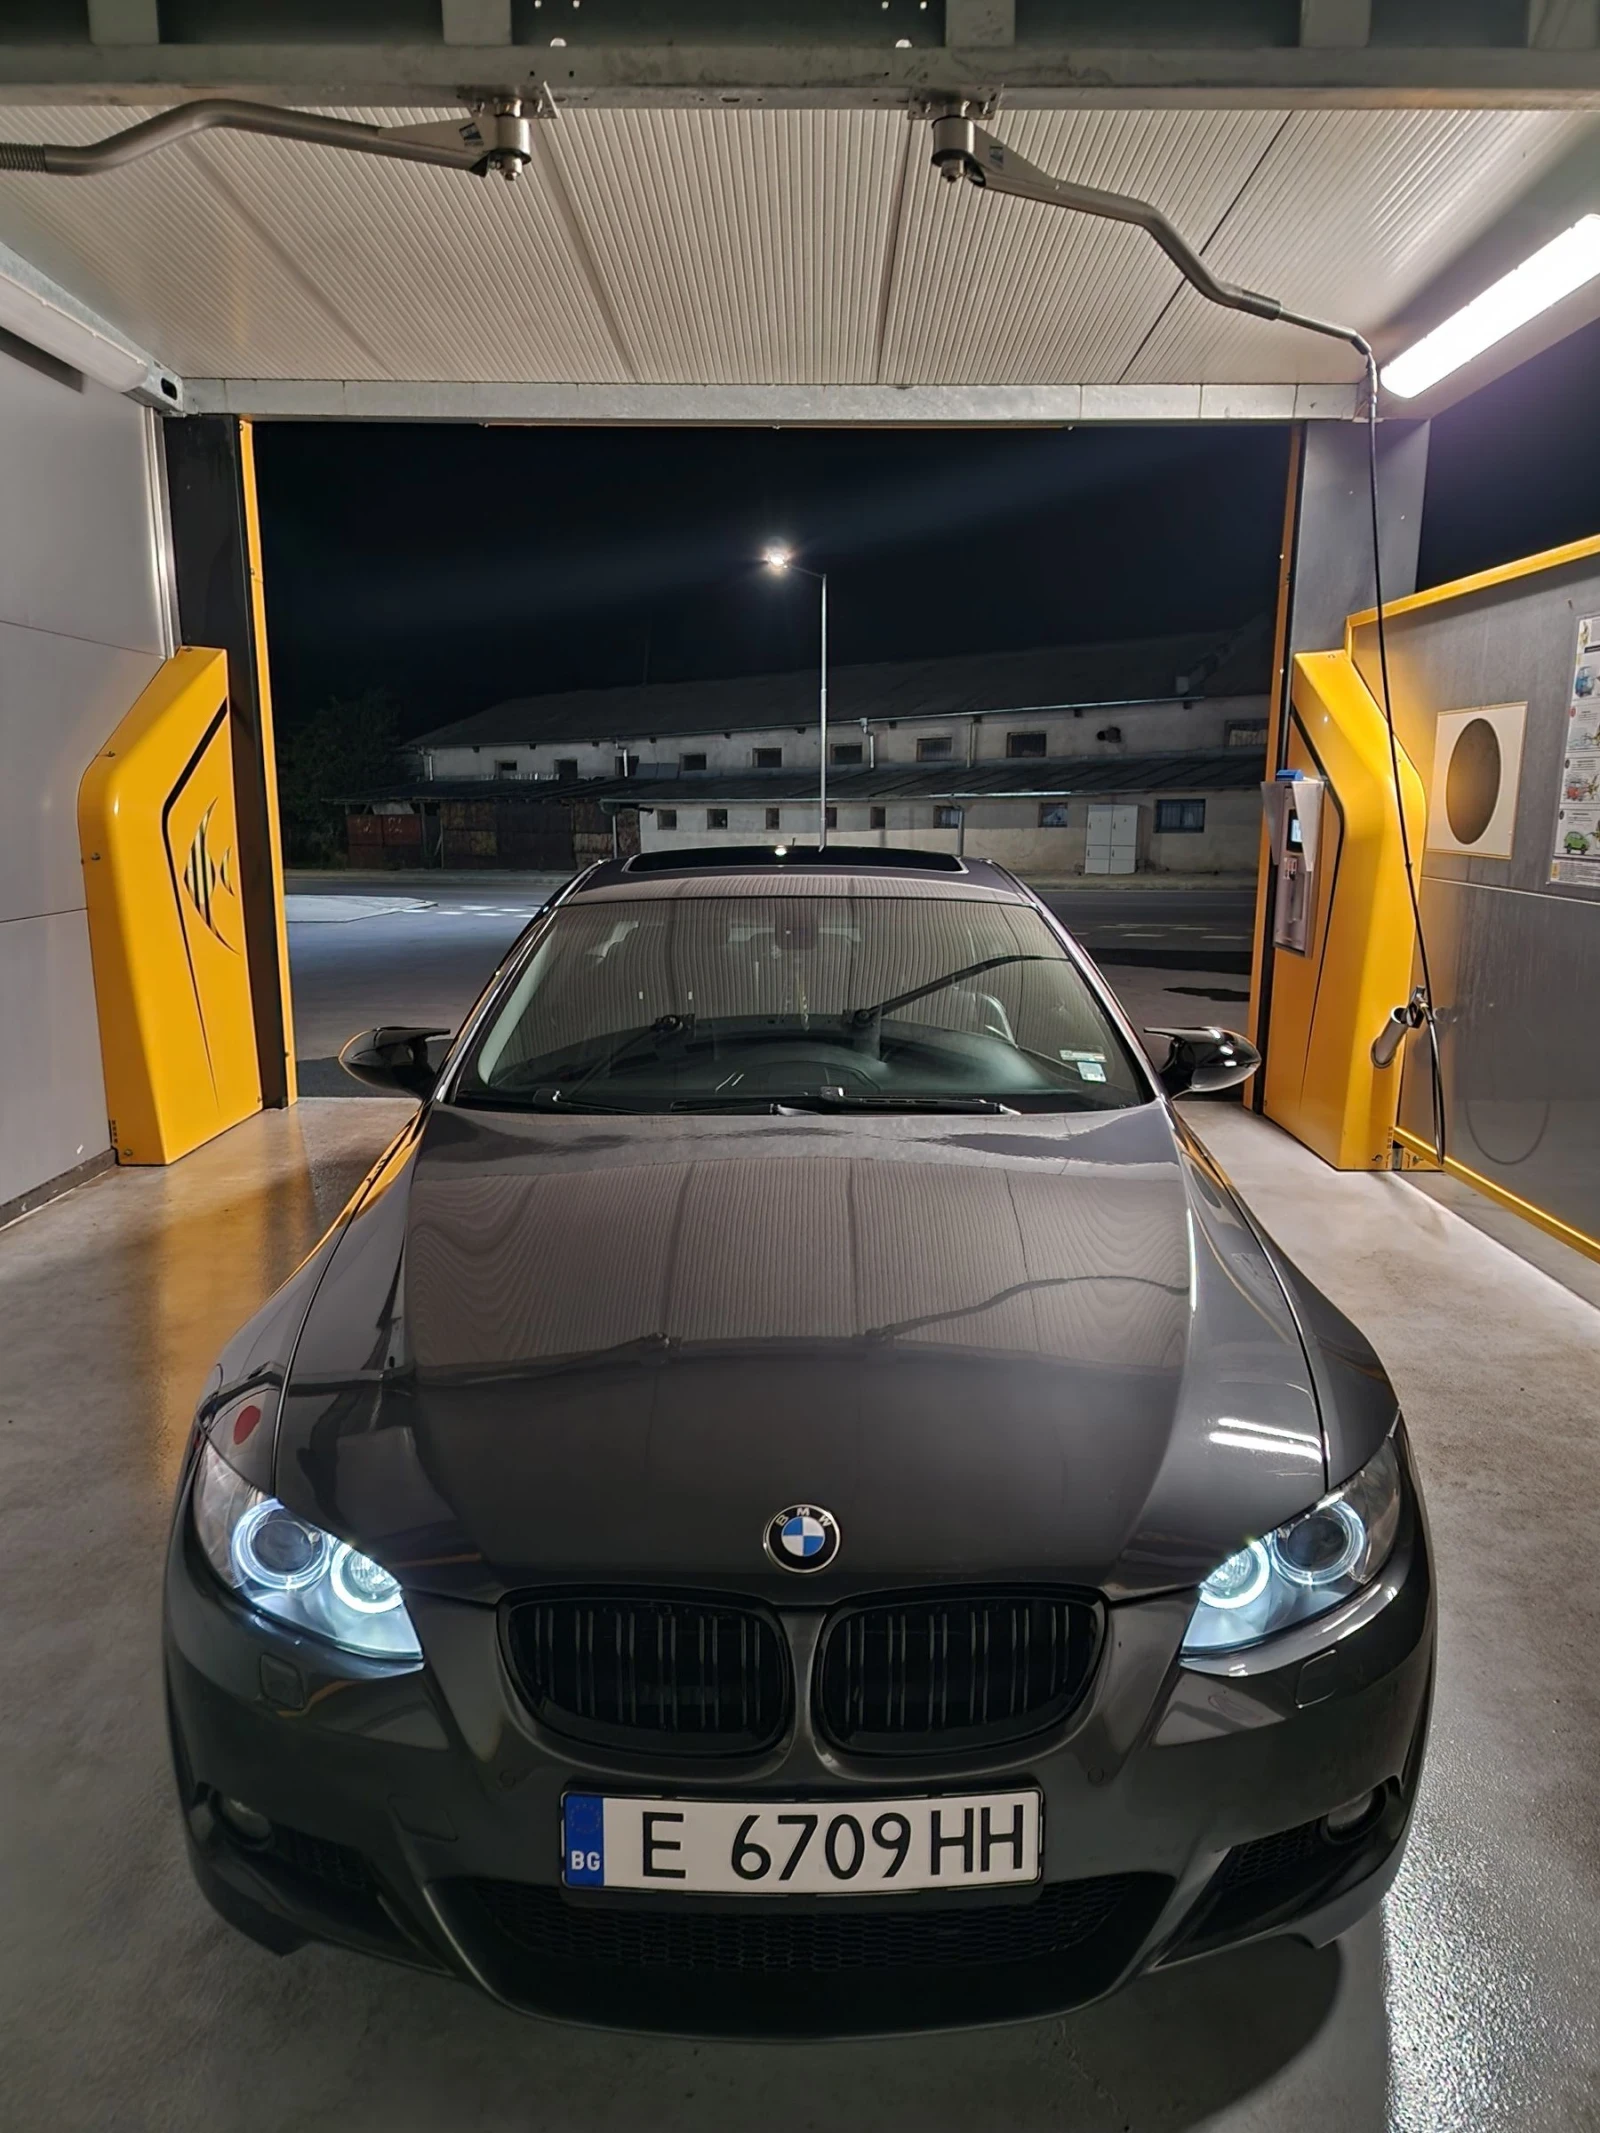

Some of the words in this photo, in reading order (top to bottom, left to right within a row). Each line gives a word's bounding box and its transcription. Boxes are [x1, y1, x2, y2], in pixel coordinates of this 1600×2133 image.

[775, 1507, 832, 1527] BMW
[642, 1811, 687, 1879] E
[731, 1813, 912, 1881] 6709
[930, 1804, 1024, 1876] HH
[571, 1850, 601, 1871] BG
